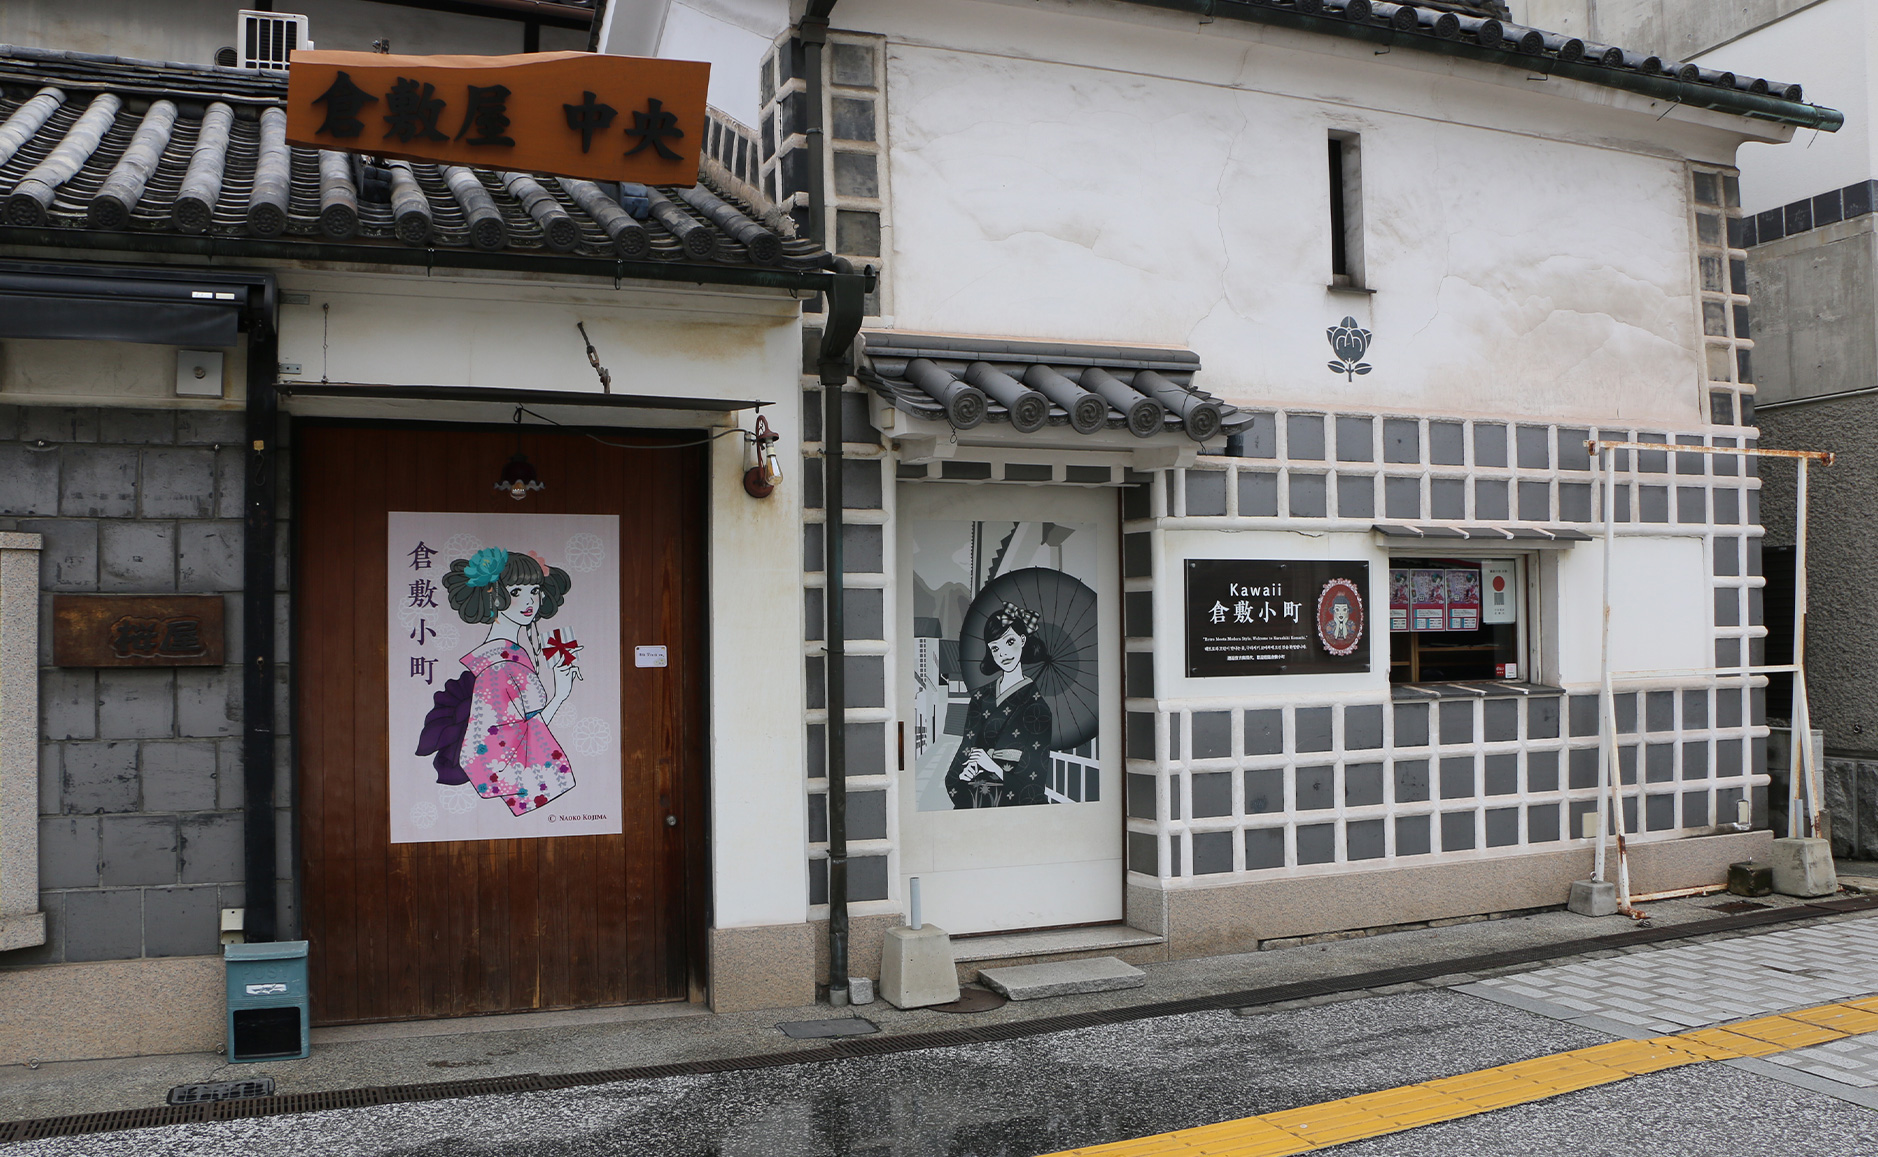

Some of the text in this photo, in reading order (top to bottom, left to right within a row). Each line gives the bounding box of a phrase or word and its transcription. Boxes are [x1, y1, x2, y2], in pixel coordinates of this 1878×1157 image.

[311, 70, 686, 161] 倉敷屋 中央
[407, 541, 439, 685] 倉敷小町
[1208, 600, 1303, 625] 倉敷小町
[1230, 583, 1282, 597] Kawaii
